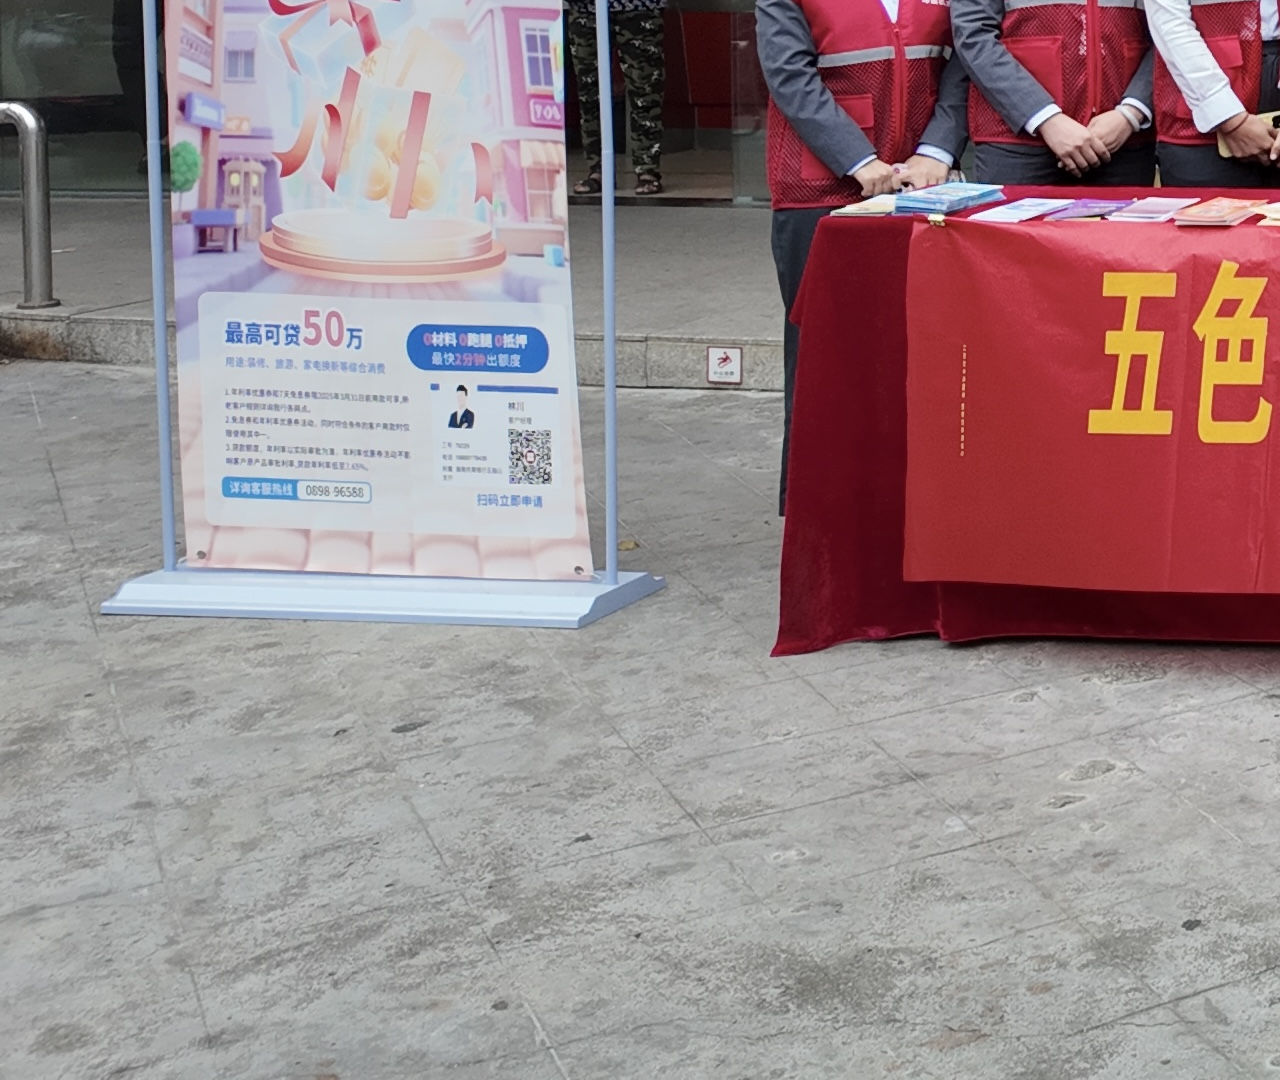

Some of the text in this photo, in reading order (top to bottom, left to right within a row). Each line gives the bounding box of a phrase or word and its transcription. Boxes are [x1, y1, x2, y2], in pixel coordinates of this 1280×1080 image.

[224, 308, 365, 351] 最高可贷50万
[423, 332, 457, 348] 0材料
[494, 333, 528, 350] 0抵押
[431, 352, 521, 368] 最快2分钟出额度
[229, 481, 293, 497] 详询客服热线
[476, 494, 544, 510] 扫码立即申请
